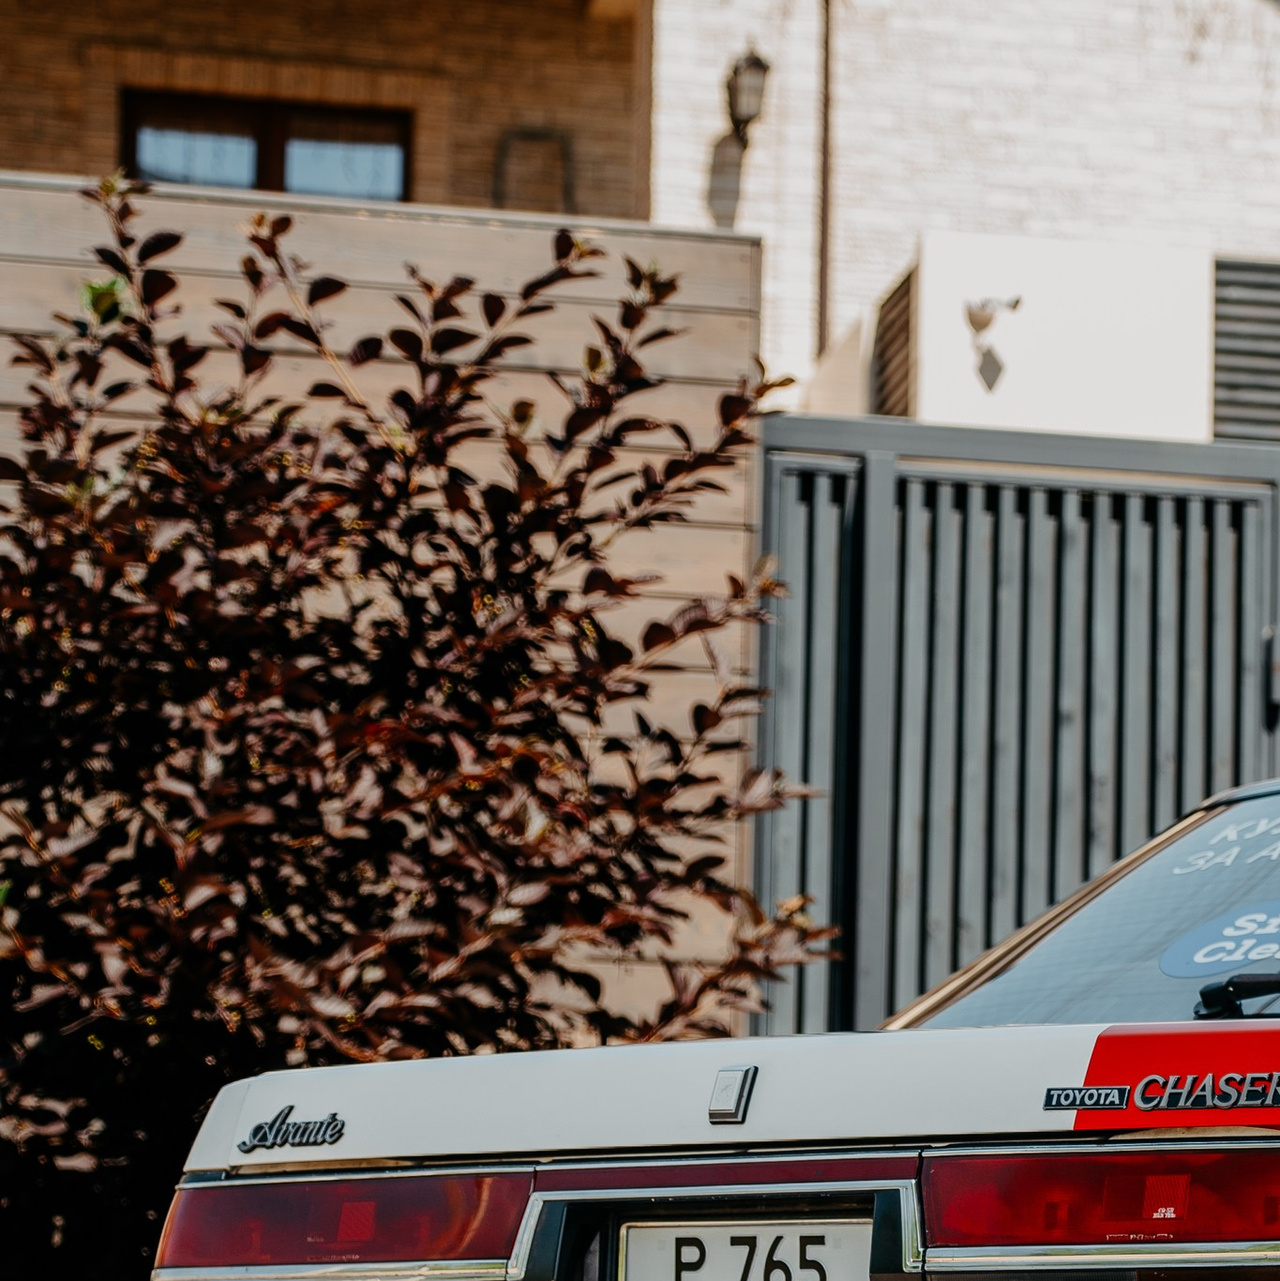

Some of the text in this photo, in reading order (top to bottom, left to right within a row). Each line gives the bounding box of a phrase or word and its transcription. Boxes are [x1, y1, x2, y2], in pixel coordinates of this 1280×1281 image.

[1172, 846, 1241, 875] ЗА
[1049, 1088, 1121, 1106] TOYOTA
[236, 1104, 346, 1154] Avante
